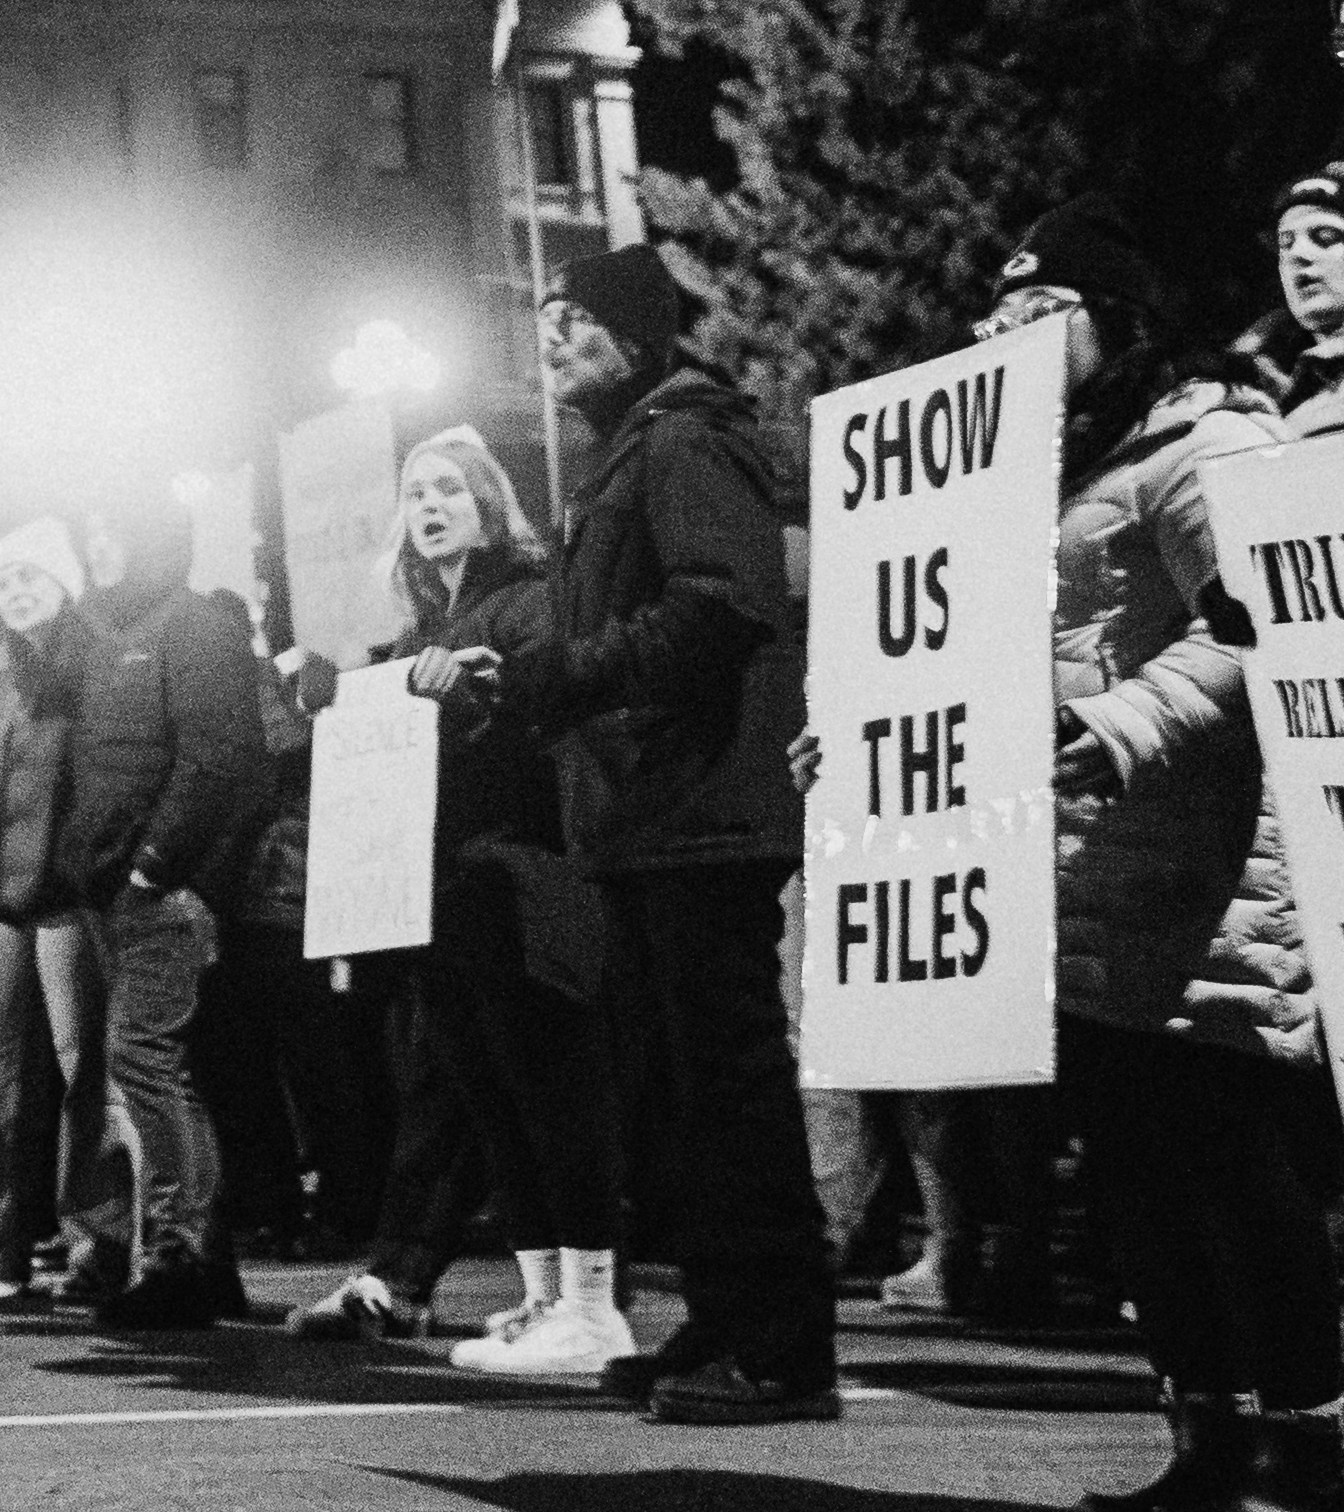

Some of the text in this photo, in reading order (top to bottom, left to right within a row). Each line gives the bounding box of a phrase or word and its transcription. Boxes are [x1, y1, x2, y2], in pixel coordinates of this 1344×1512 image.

[841, 364, 1006, 513] SHOW
[876, 546, 952, 659] US
[861, 702, 968, 818] THE
[835, 865, 992, 987] FILES
